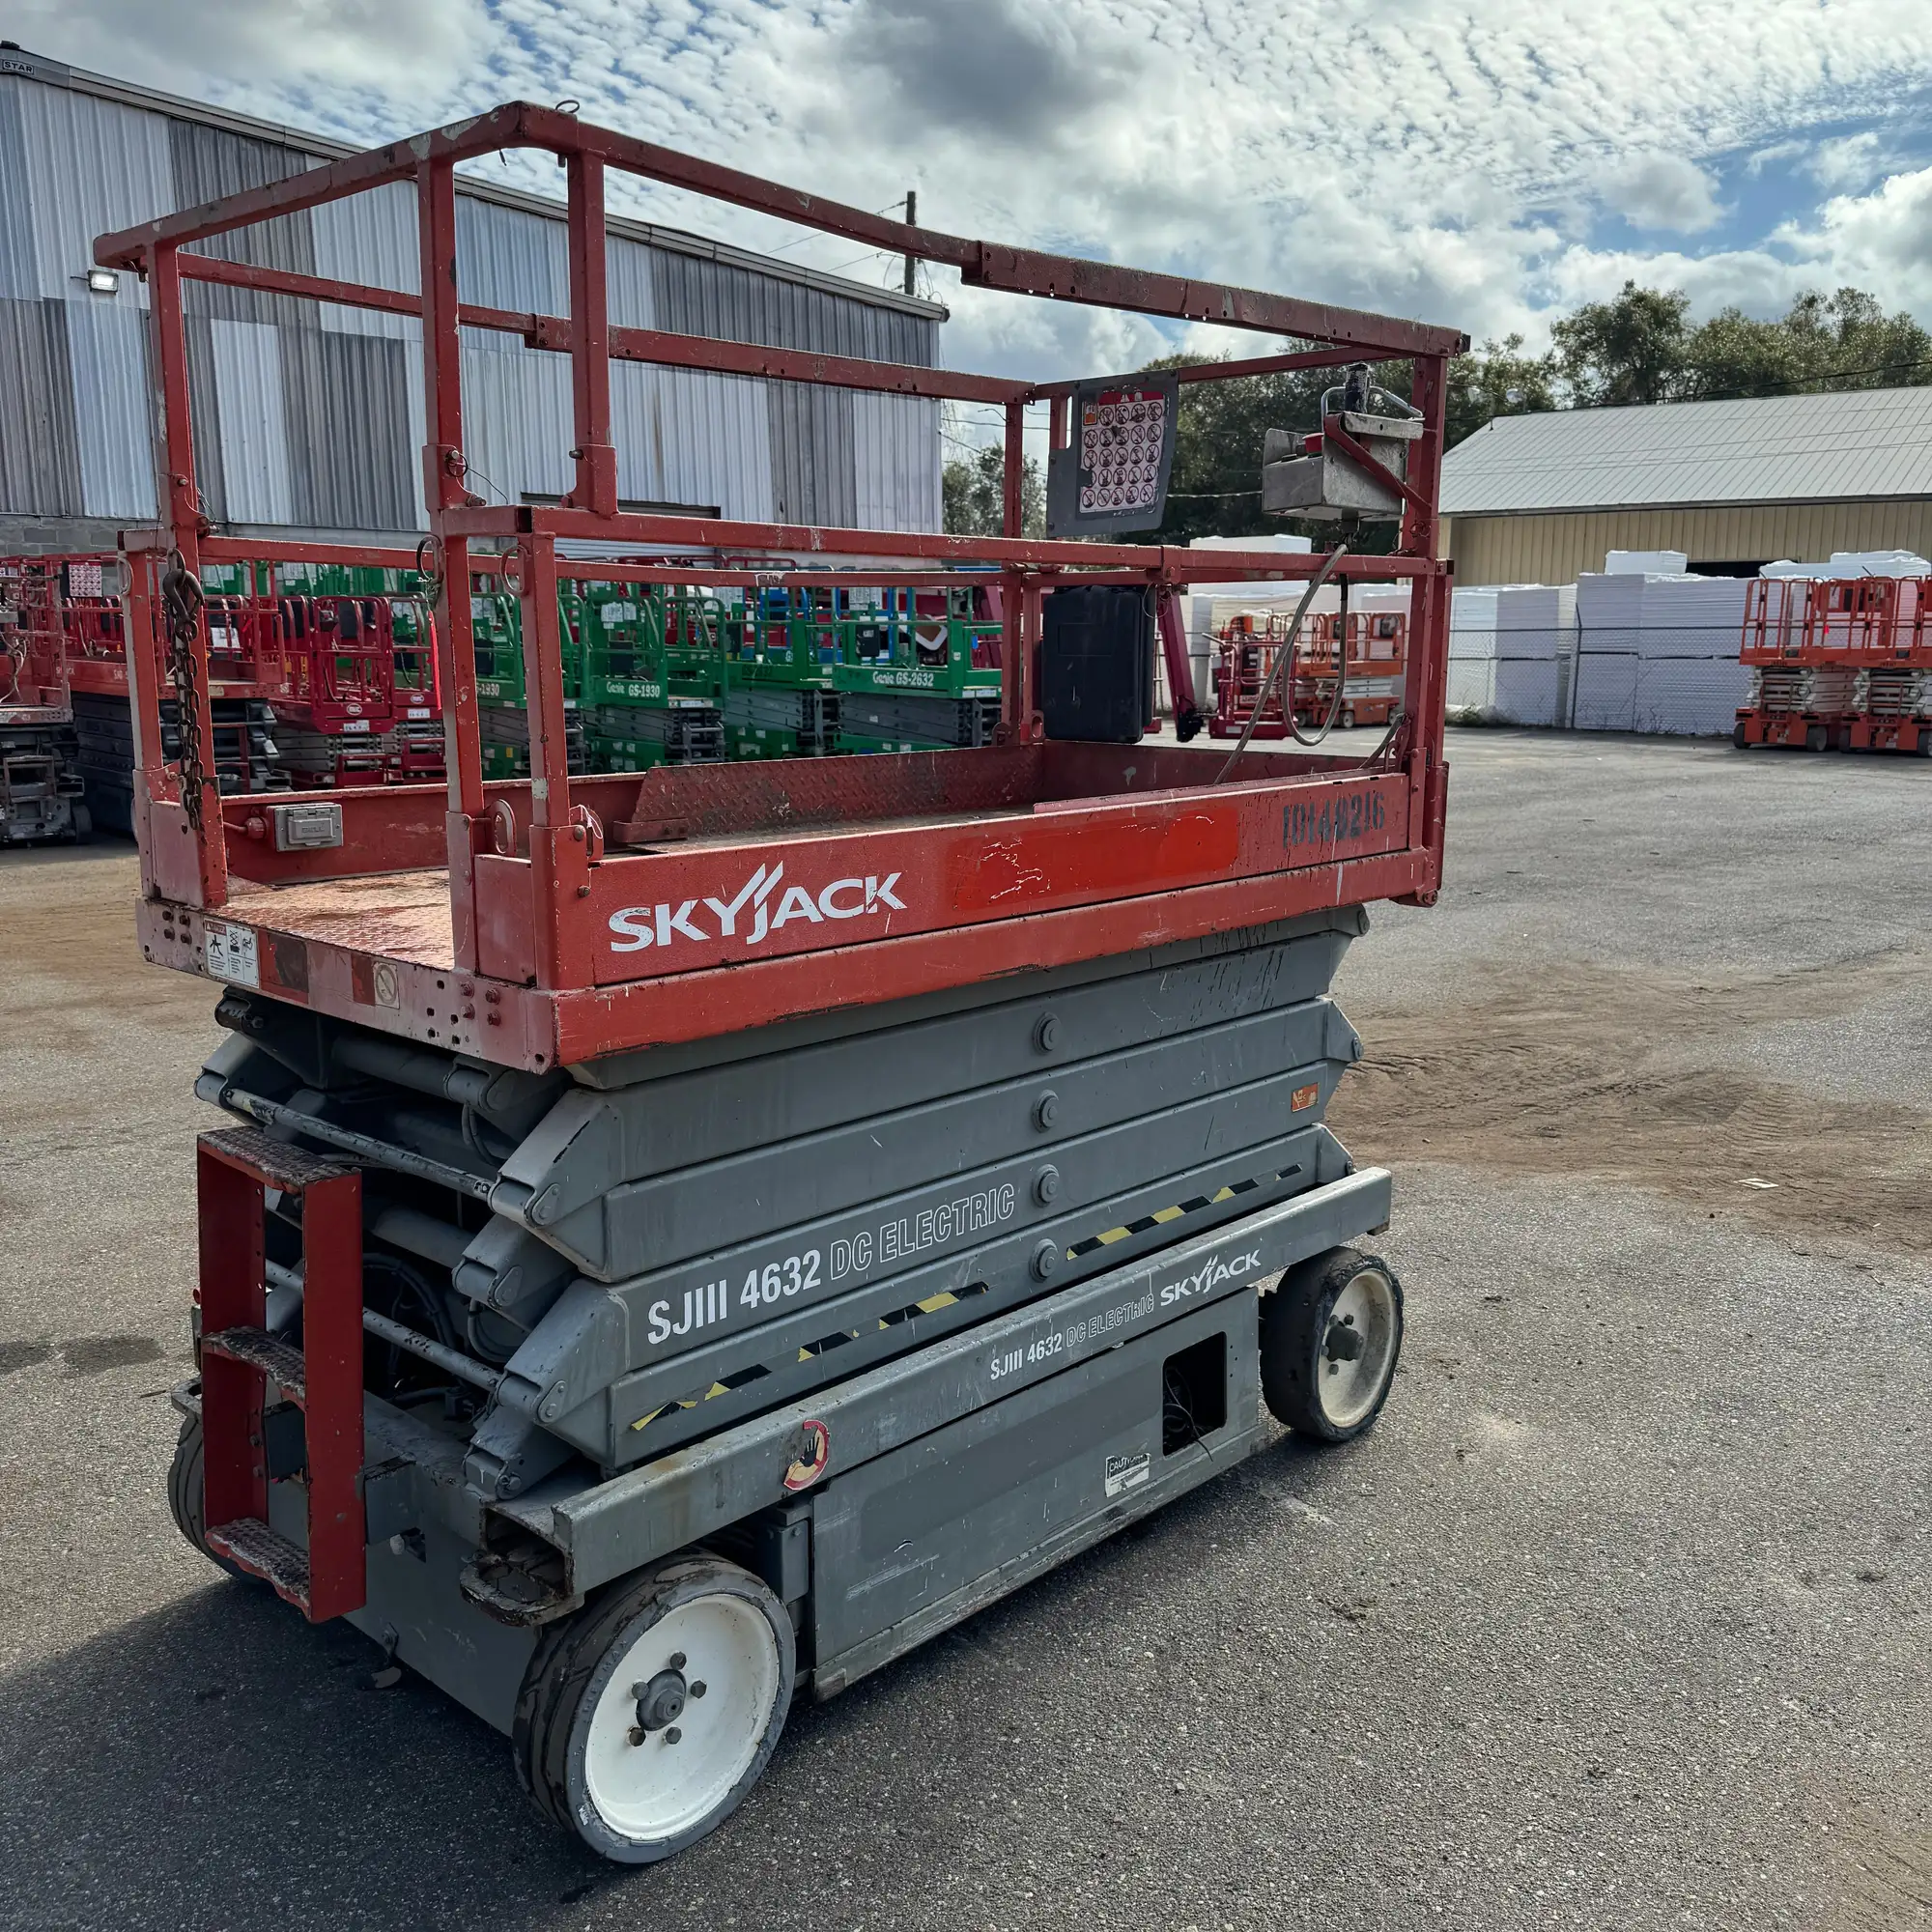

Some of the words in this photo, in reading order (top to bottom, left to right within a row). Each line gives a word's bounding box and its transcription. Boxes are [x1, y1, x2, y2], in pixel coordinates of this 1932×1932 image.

[5, 61, 33, 73] STAR
[873, 671, 894, 684] Genie
[896, 671, 934, 687] GS-2632
[476, 682, 499, 696] -1930
[629, 684, 661, 697] GS-1930
[609, 861, 907, 952] SKYJACK
[647, 1279, 727, 1345] SJIII
[739, 1249, 821, 1310] 4632
[830, 1232, 872, 1281] DC
[880, 1182, 1015, 1264] ELECTRIC
[1027, 1332, 1063, 1363] 4632
[1066, 1322, 1087, 1348] DC
[1089, 1293, 1154, 1338] ELECTRIC
[1160, 1249, 1262, 1306] SKYJACK
